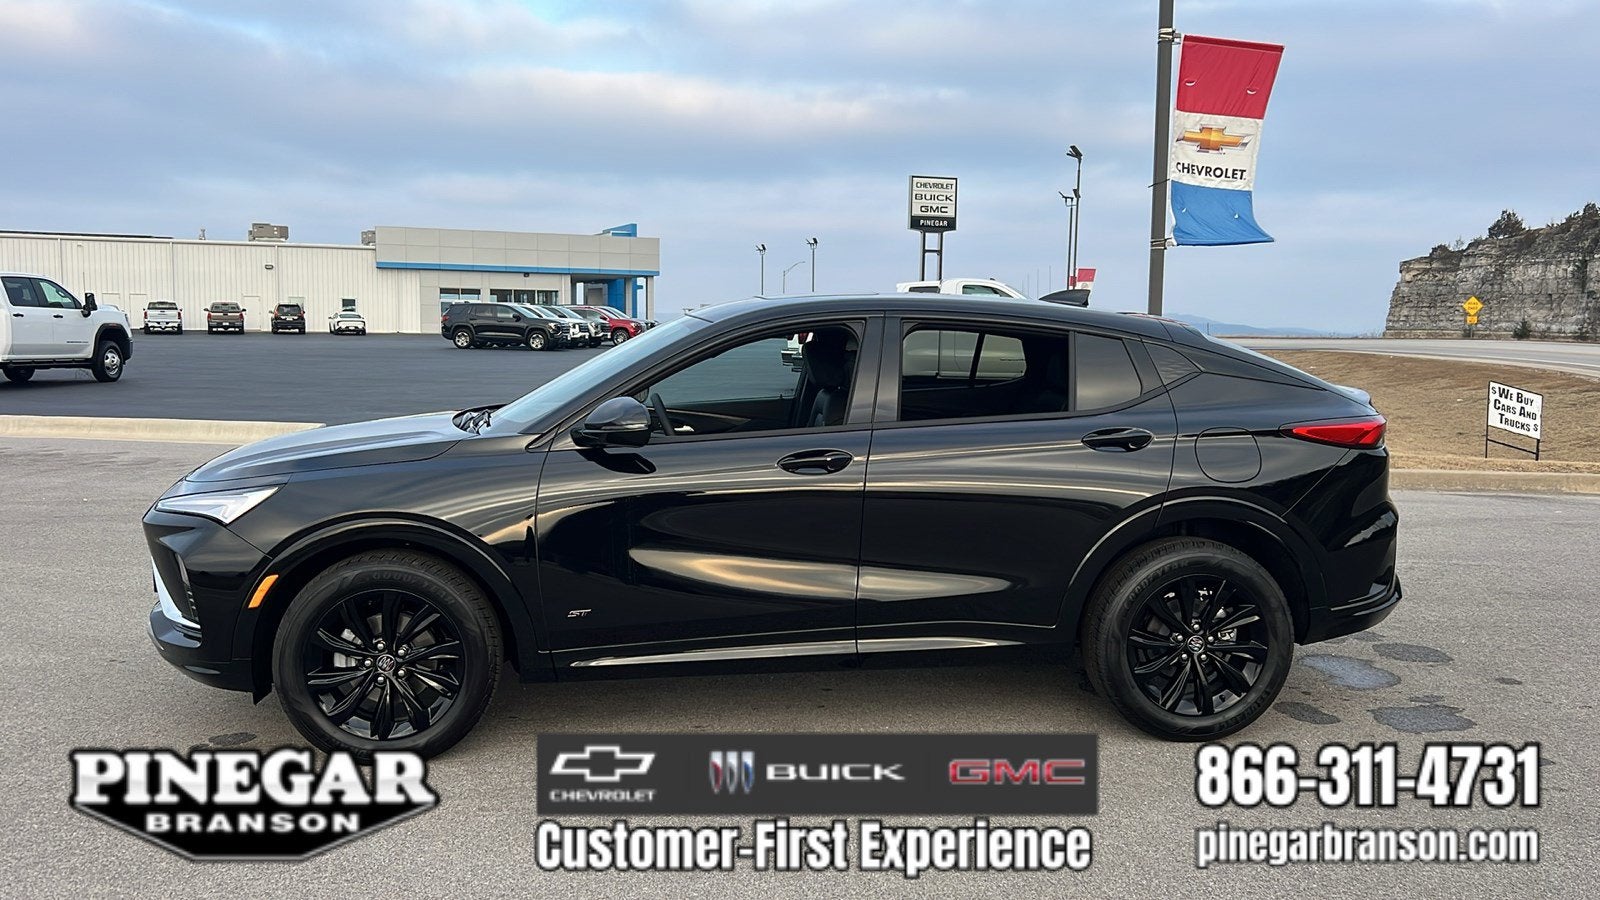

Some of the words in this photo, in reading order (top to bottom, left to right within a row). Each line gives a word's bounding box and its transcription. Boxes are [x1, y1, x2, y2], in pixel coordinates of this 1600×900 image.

[915, 181, 954, 190] CHEVROLET
[914, 193, 954, 202] BUICK
[919, 205, 949, 214] GMC
[919, 219, 948, 227] PINEGAR
